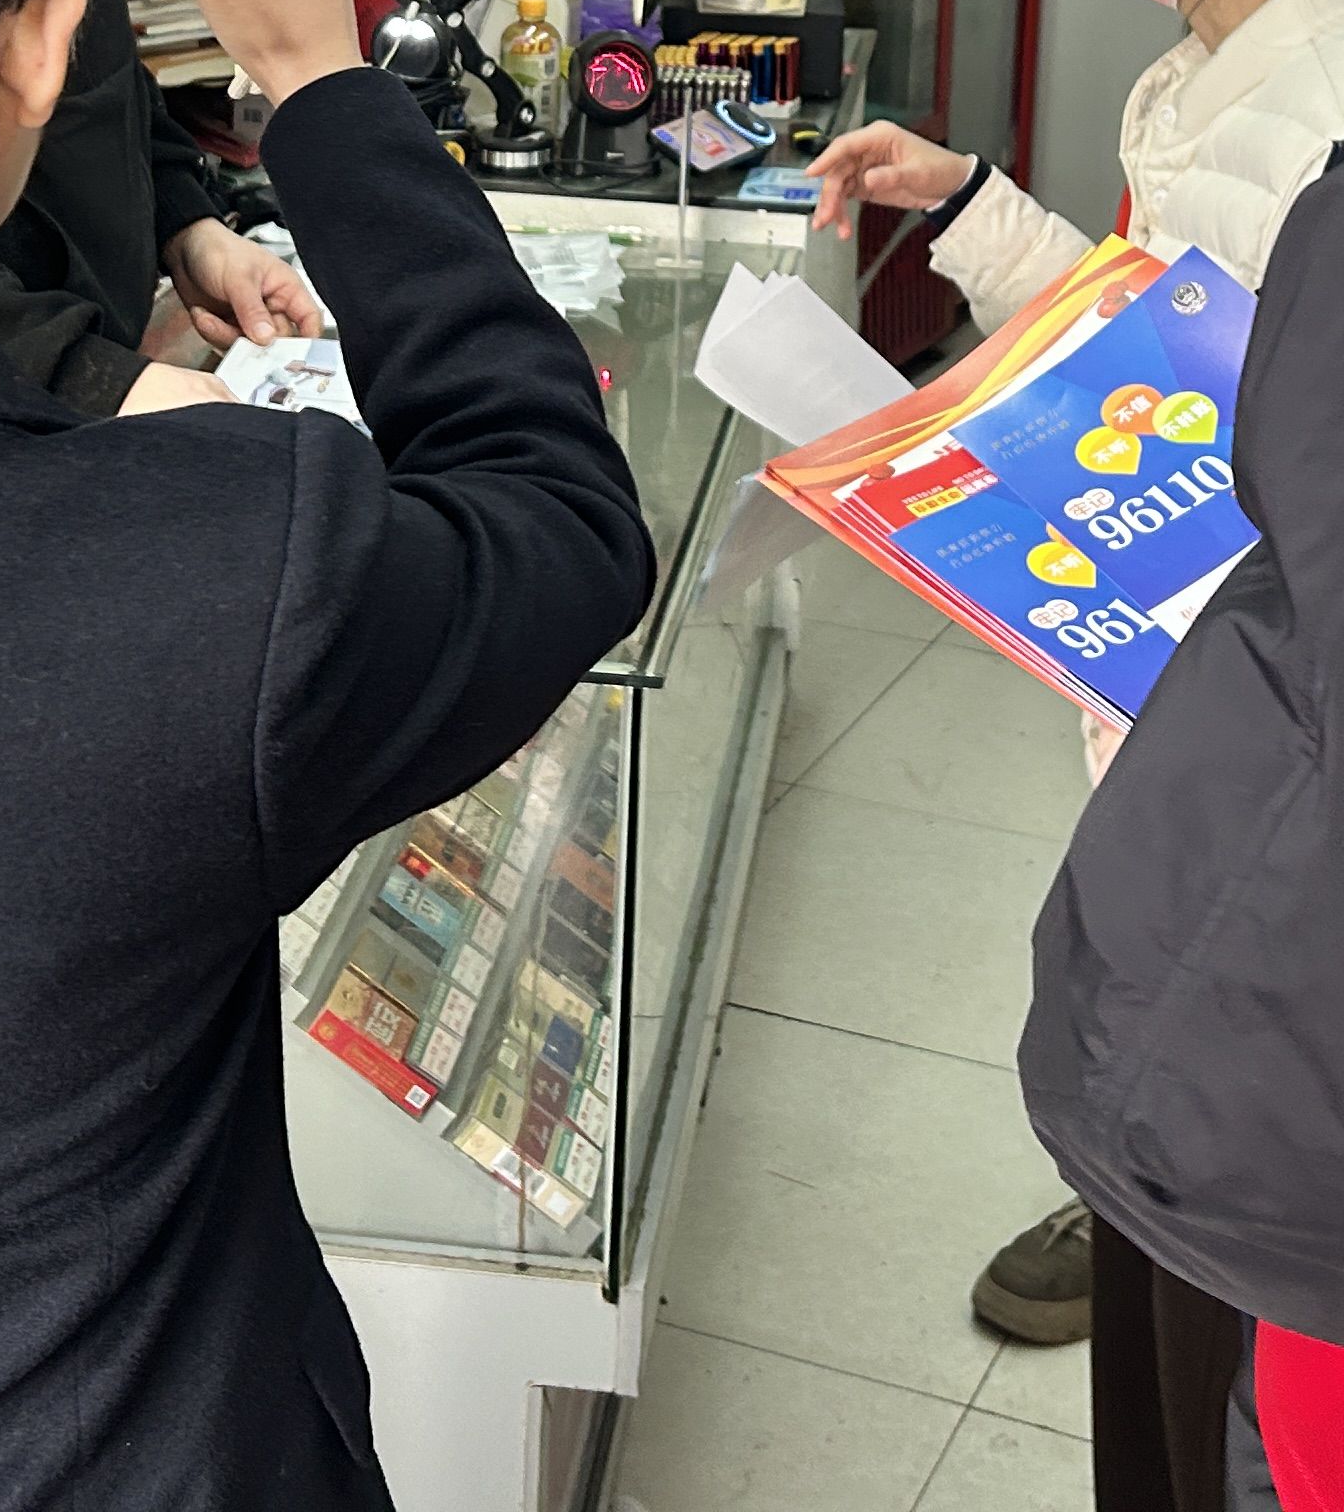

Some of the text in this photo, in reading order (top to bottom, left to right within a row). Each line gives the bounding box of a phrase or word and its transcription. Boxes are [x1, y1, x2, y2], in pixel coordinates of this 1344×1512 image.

[1112, 393, 1153, 424] 不信
[1157, 399, 1213, 440] 不转账
[1068, 490, 1113, 518] 牢记
[1088, 455, 1235, 551] 96110
[1031, 601, 1077, 627] 牢记
[1056, 597, 1157, 660] 961
